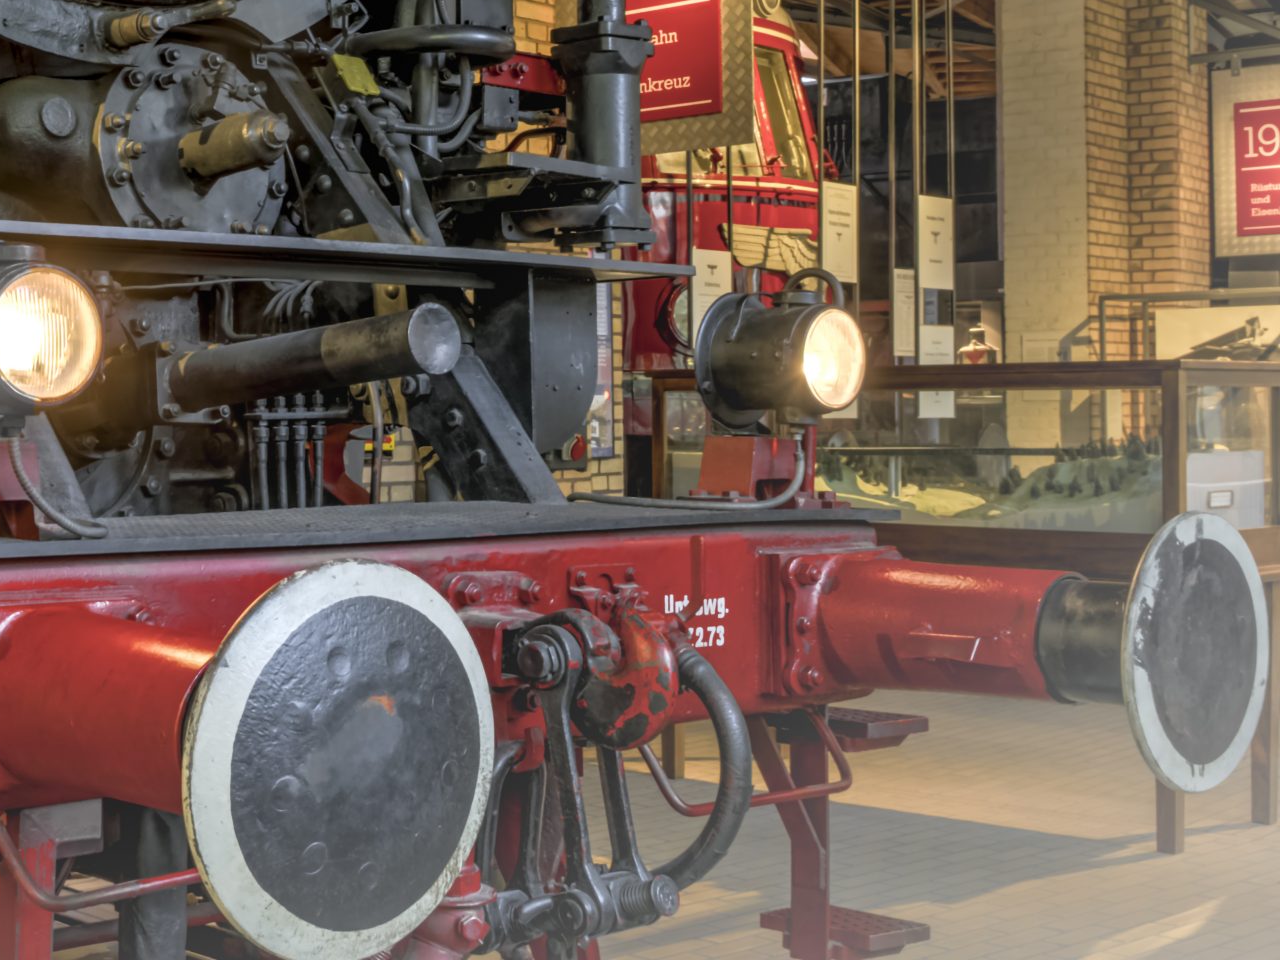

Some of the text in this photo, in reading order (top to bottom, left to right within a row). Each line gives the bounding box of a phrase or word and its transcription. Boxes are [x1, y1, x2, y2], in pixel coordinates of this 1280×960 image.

[649, 29, 679, 46] ahn
[1242, 123, 1280, 158] 19
[1250, 194, 1271, 205] und
[1251, 206, 1280, 217] Eisen
